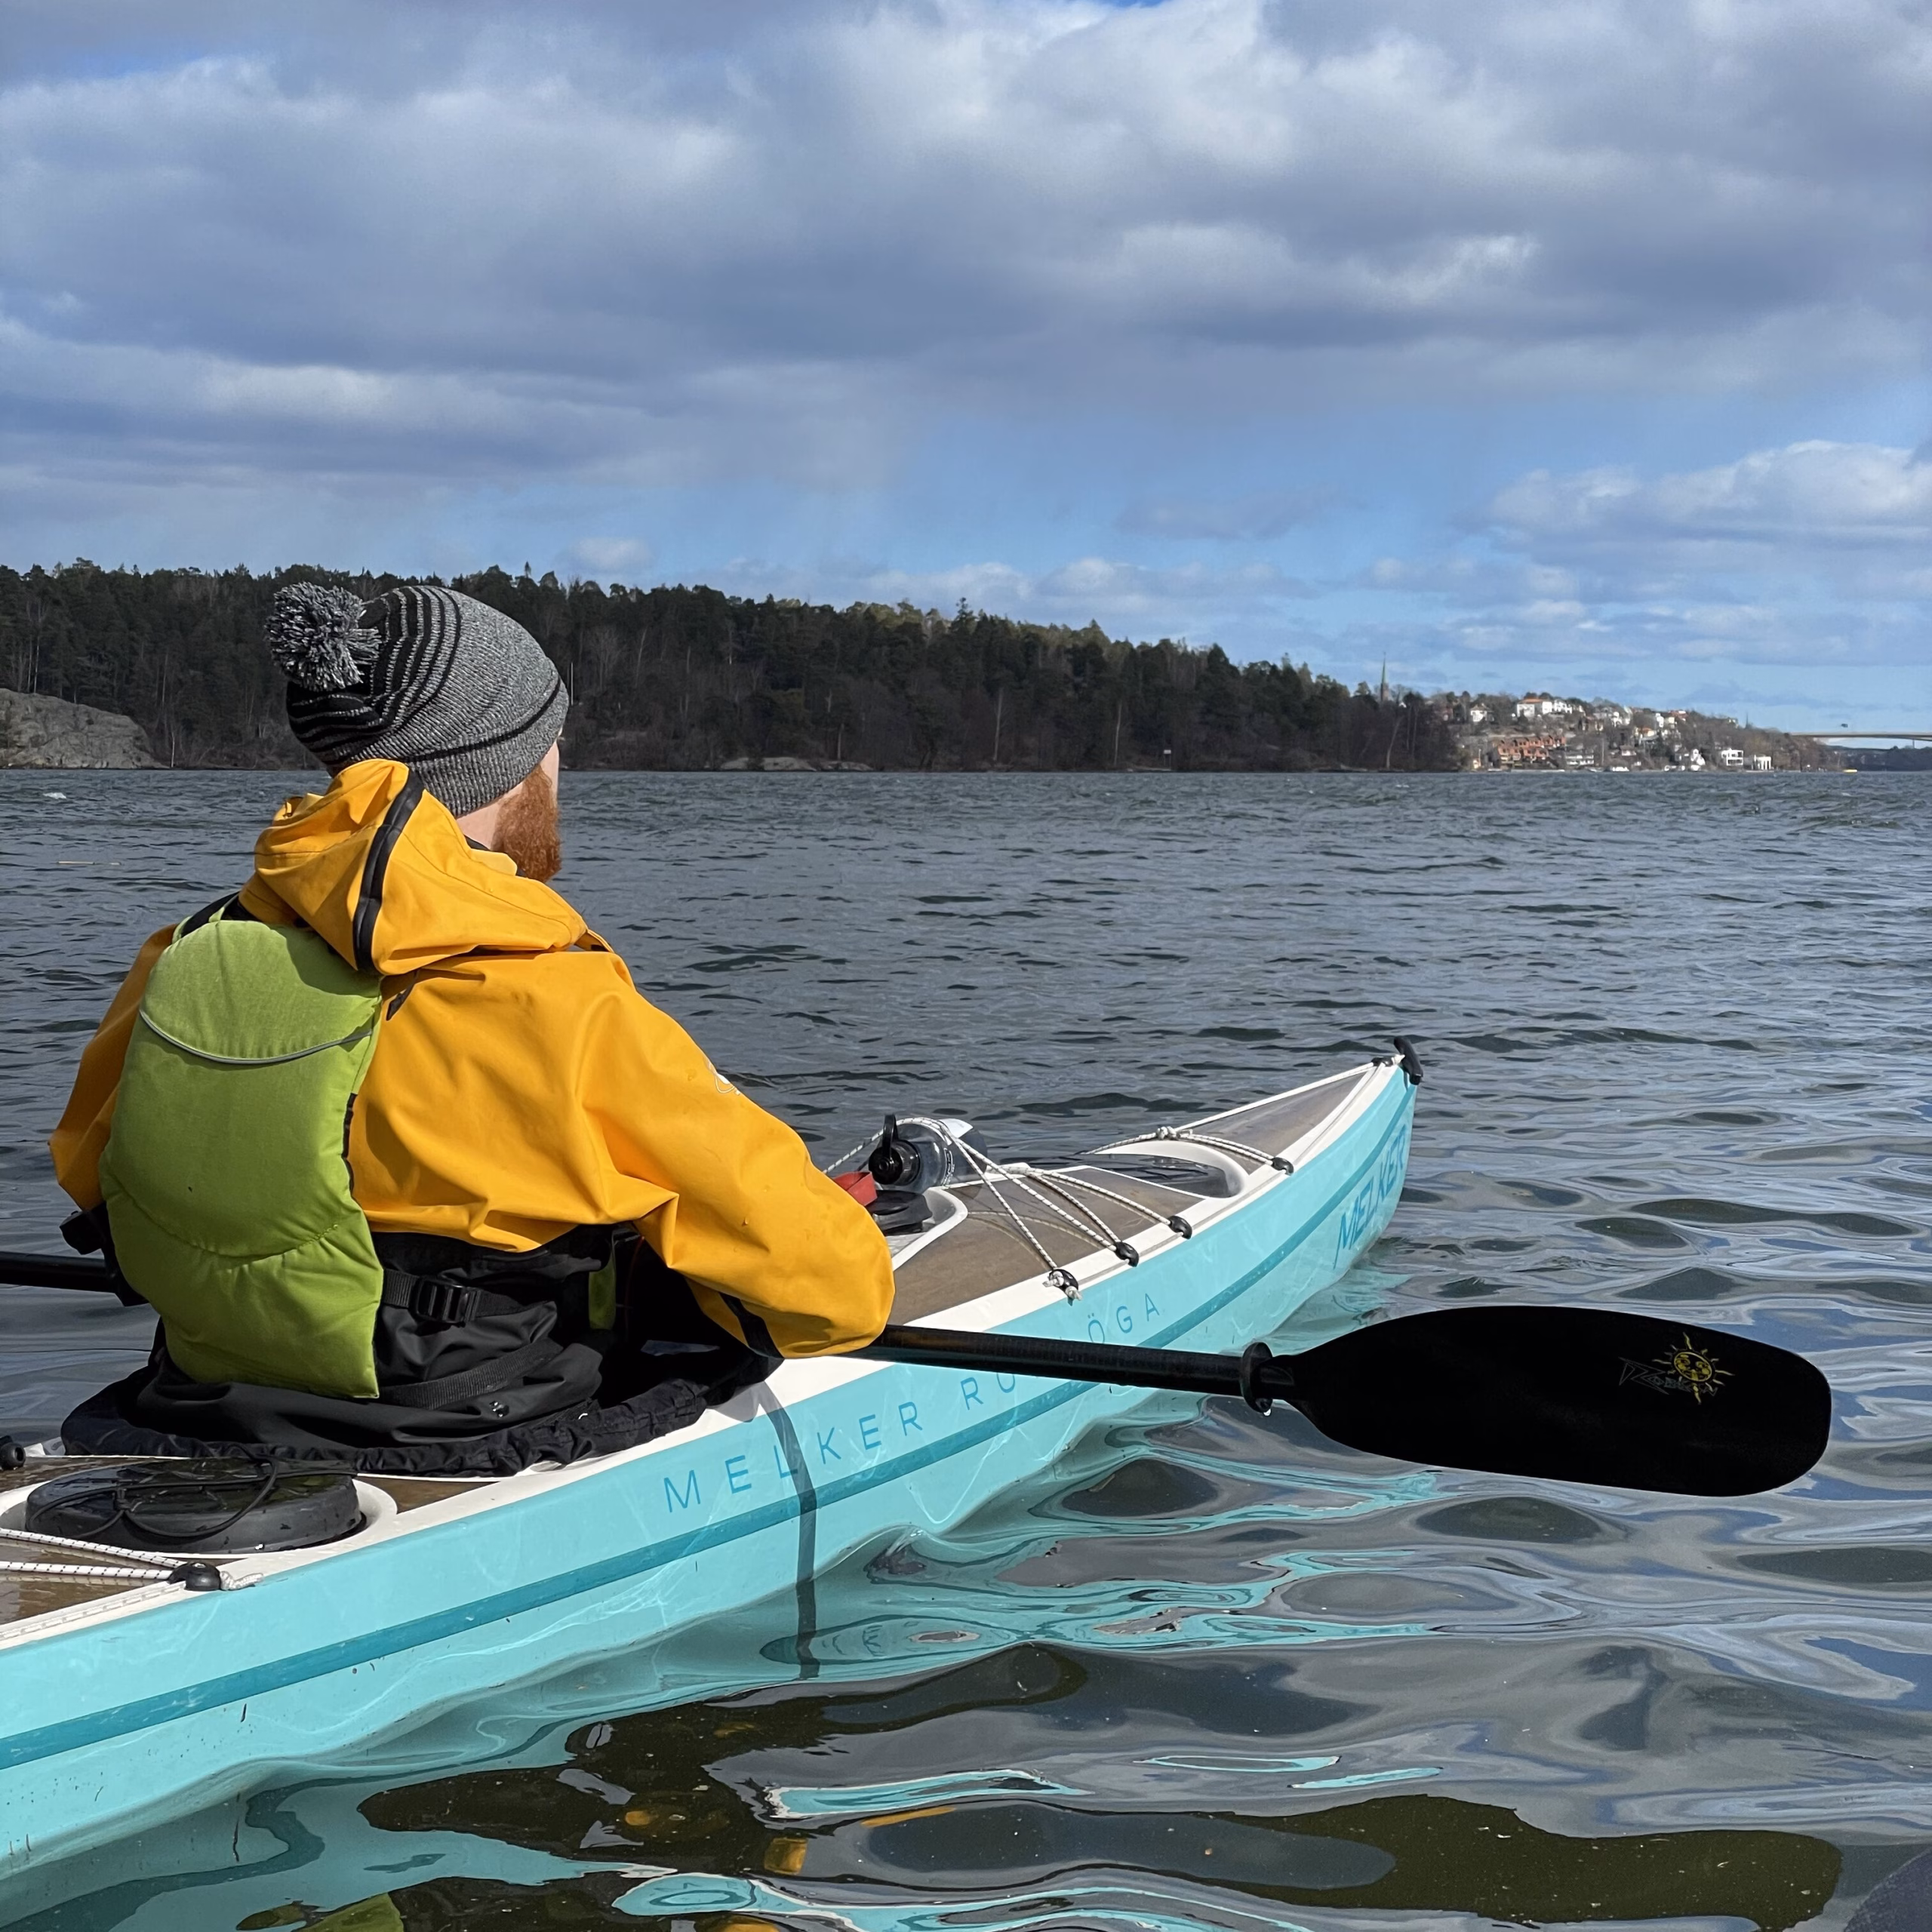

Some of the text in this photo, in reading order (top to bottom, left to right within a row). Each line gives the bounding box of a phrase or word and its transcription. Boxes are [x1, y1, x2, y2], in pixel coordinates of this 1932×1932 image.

[1333, 1124, 1406, 1269] MELKER
[664, 1293, 1160, 1512] MELKER RÖGA
